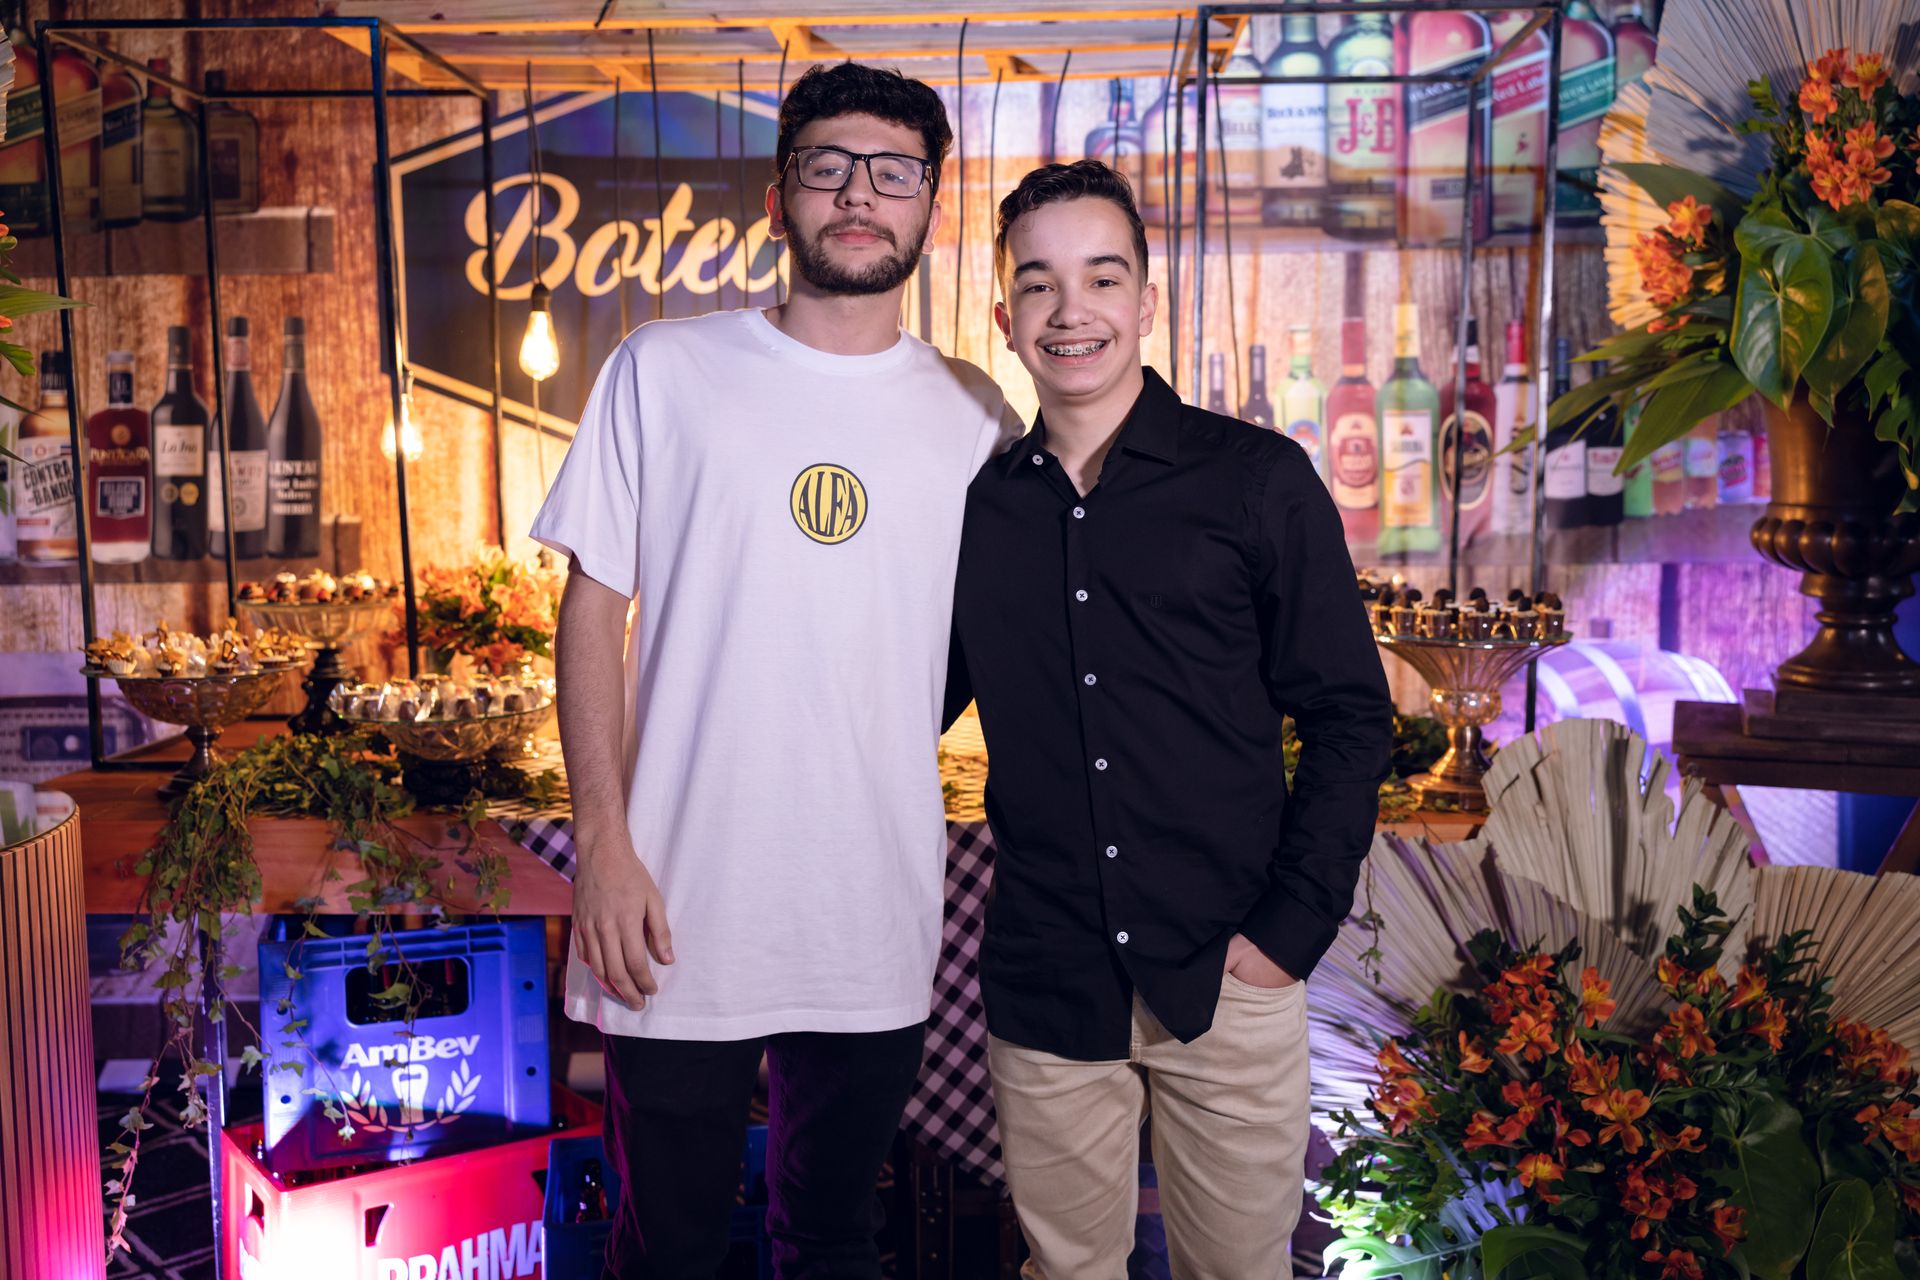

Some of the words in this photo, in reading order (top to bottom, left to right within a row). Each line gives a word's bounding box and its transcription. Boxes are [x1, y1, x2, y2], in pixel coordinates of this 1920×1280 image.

[1336, 97, 1395, 154] J&B
[464, 172, 790, 300] Botec
[23, 459, 72, 490] CONTRA
[799, 471, 858, 537] ALFA
[340, 1034, 481, 1069] AmBev
